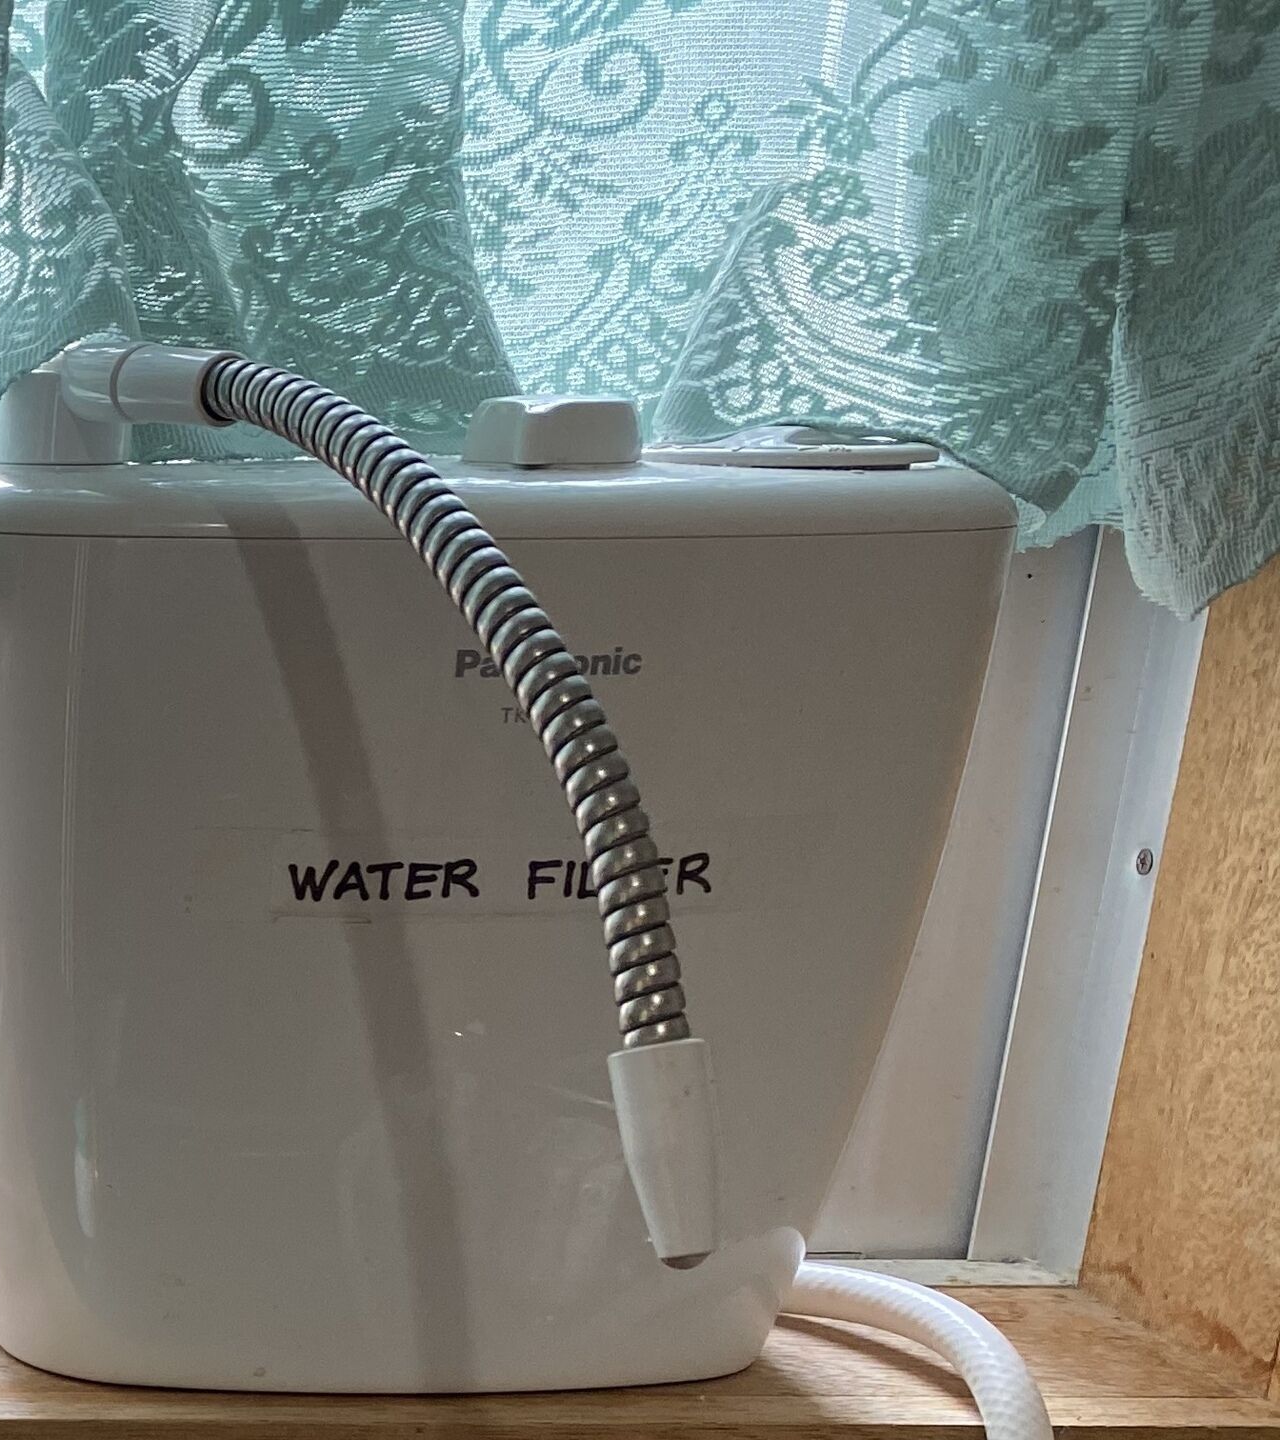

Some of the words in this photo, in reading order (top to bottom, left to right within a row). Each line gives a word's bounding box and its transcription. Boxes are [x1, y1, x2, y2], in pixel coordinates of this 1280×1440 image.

[455, 647, 642, 678] Paonic
[288, 858, 480, 902] WATER
[528, 852, 712, 900] FILR
